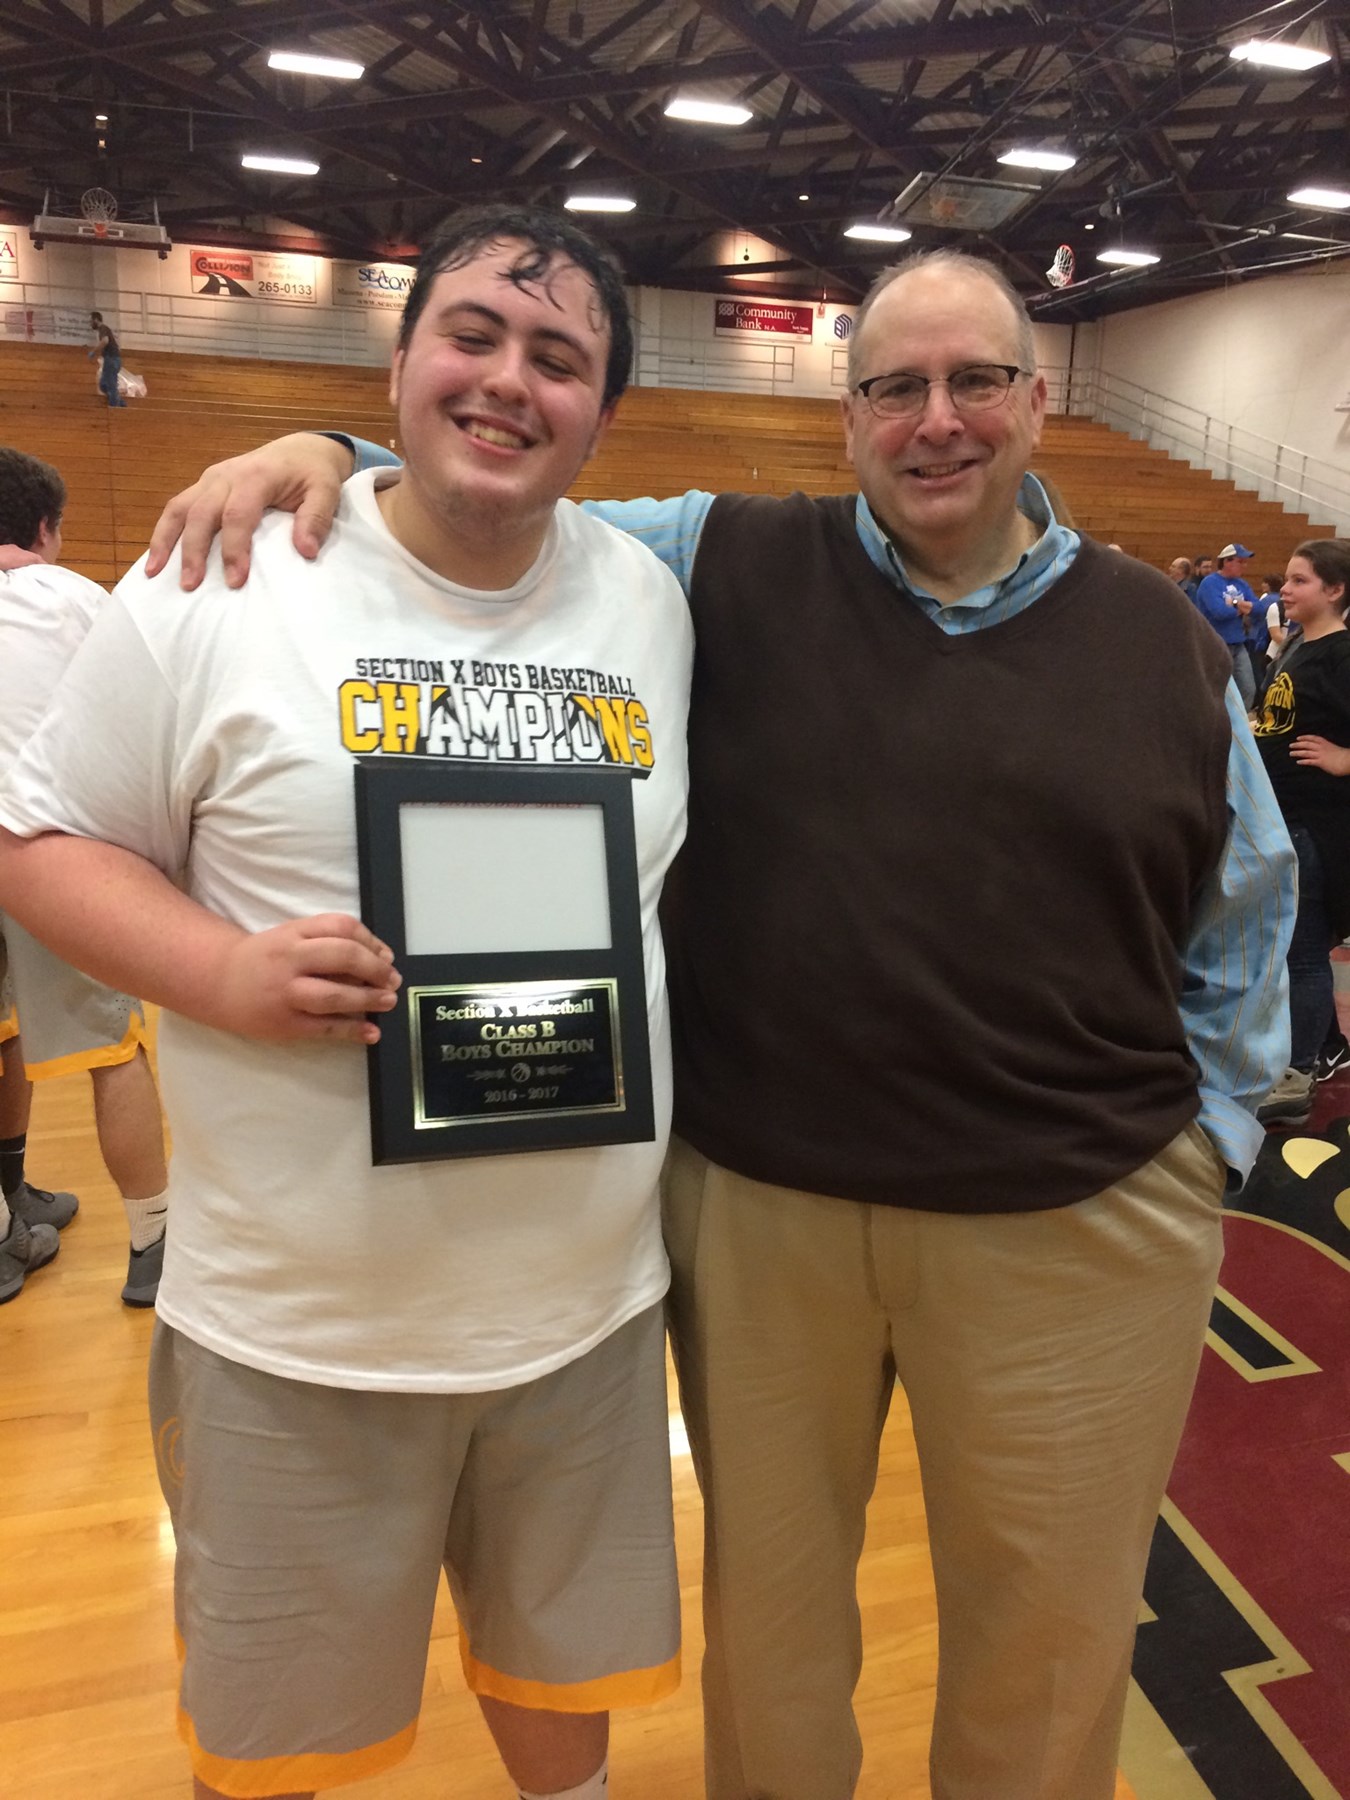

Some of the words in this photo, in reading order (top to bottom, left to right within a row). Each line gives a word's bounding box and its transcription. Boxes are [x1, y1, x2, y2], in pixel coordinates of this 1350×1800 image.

[195, 256, 251, 273] COLLISION
[258, 281, 312, 296] 265-0133
[735, 304, 798, 324] Community
[735, 318, 762, 330] Bank
[355, 658, 445, 683] SECTION
[450, 659, 467, 684] X
[471, 660, 522, 688] BOYS
[525, 664, 637, 697] BASKETBALL
[339, 678, 656, 769] CHAMPIONS
[435, 1003, 497, 1021] Section
[515, 998, 595, 1018] Basketball
[480, 1023, 538, 1041] CLASS
[540, 1021, 557, 1038] B
[440, 1044, 493, 1062] BOYS
[495, 1038, 595, 1058] CHAMPION
[483, 1088, 518, 1104] 2016
[528, 1086, 560, 1100] 2017
